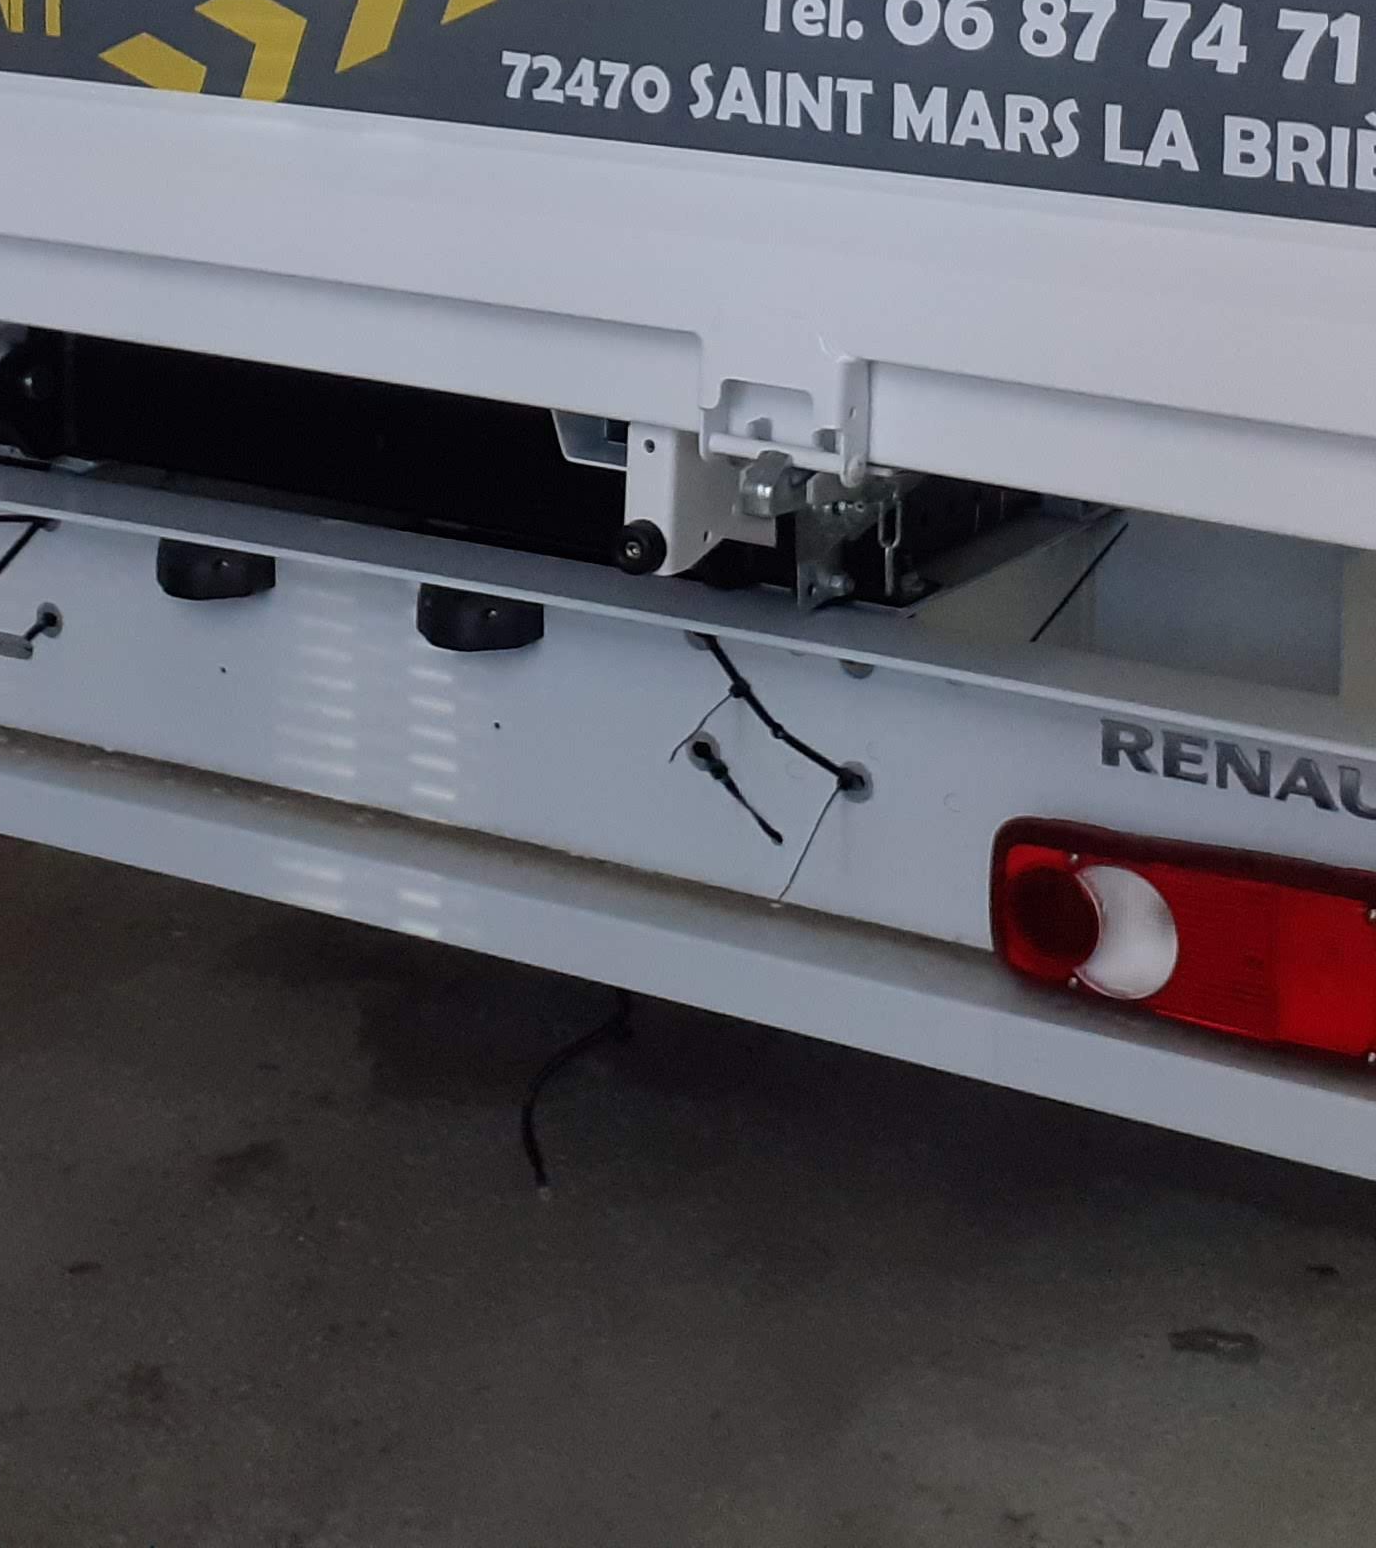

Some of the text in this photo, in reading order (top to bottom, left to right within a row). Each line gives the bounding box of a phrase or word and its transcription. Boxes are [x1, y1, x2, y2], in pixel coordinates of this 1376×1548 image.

[1277, 8, 1361, 84] 71
[500, 50, 671, 114] 72470
[688, 62, 874, 136] SAINT
[892, 82, 1081, 158] MARS
[1103, 103, 1200, 172] LA
